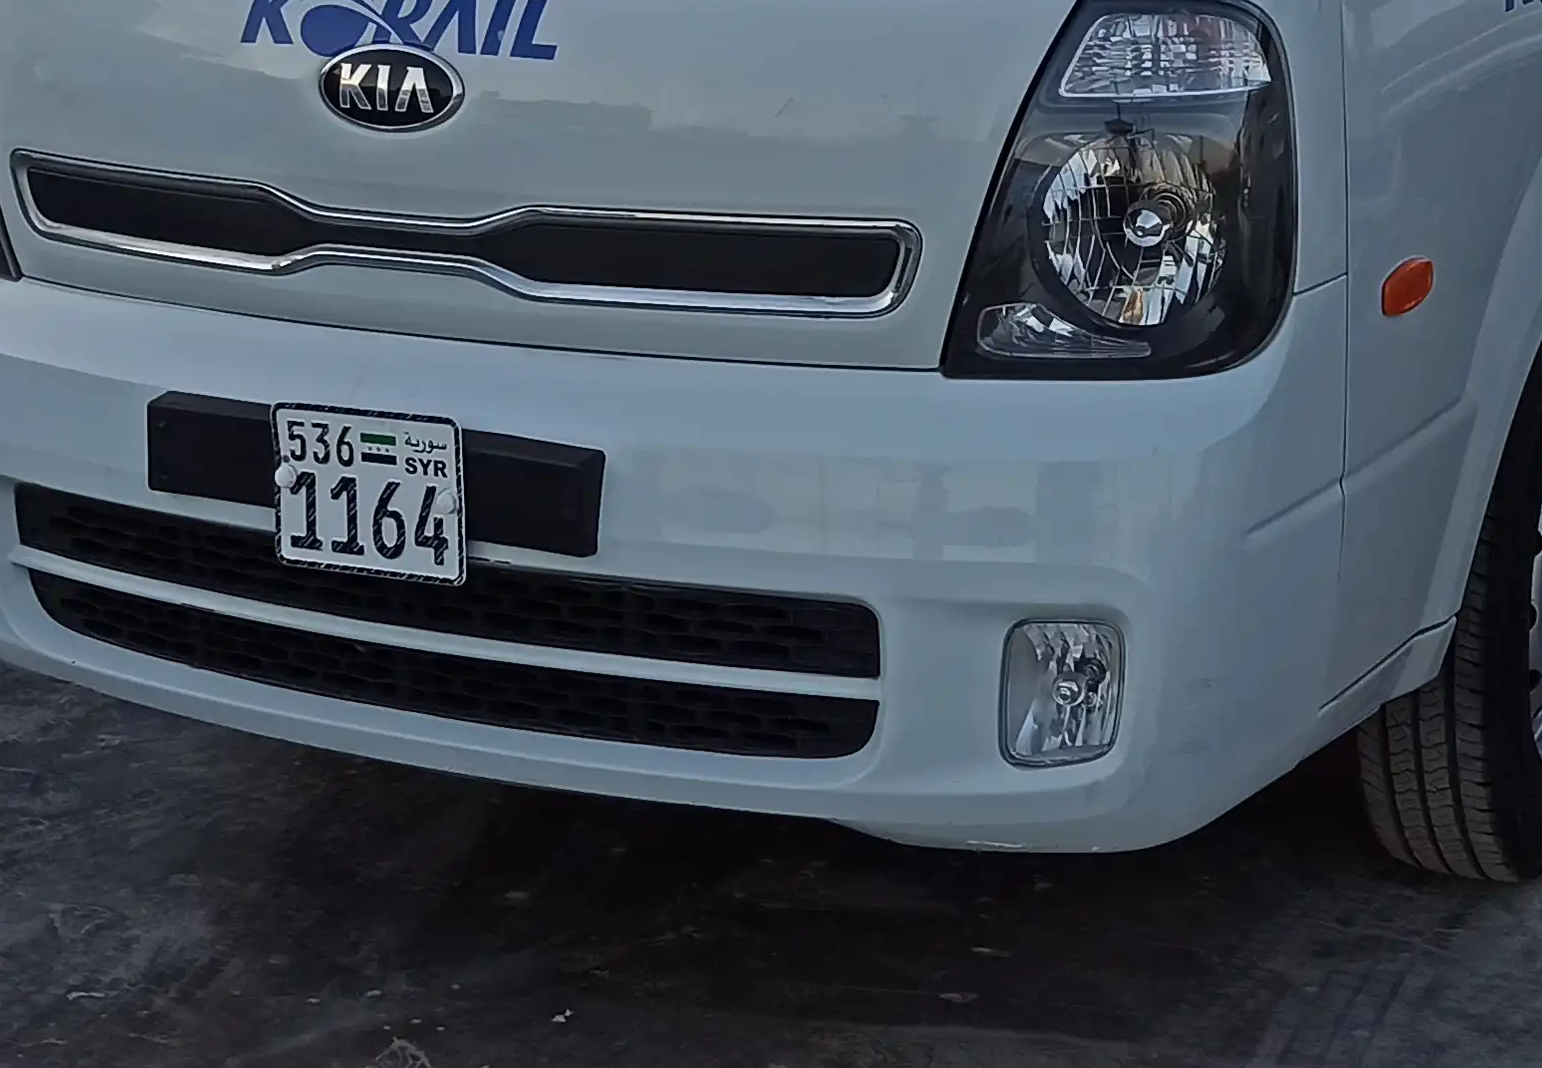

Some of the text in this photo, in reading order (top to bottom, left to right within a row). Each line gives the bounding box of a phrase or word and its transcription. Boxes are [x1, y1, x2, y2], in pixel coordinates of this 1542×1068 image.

[339, 63, 434, 113] KIA
[285, 420, 355, 468] 536
[403, 431, 448, 453] سورية
[404, 456, 448, 479] SYR
[289, 471, 450, 566] 1164
